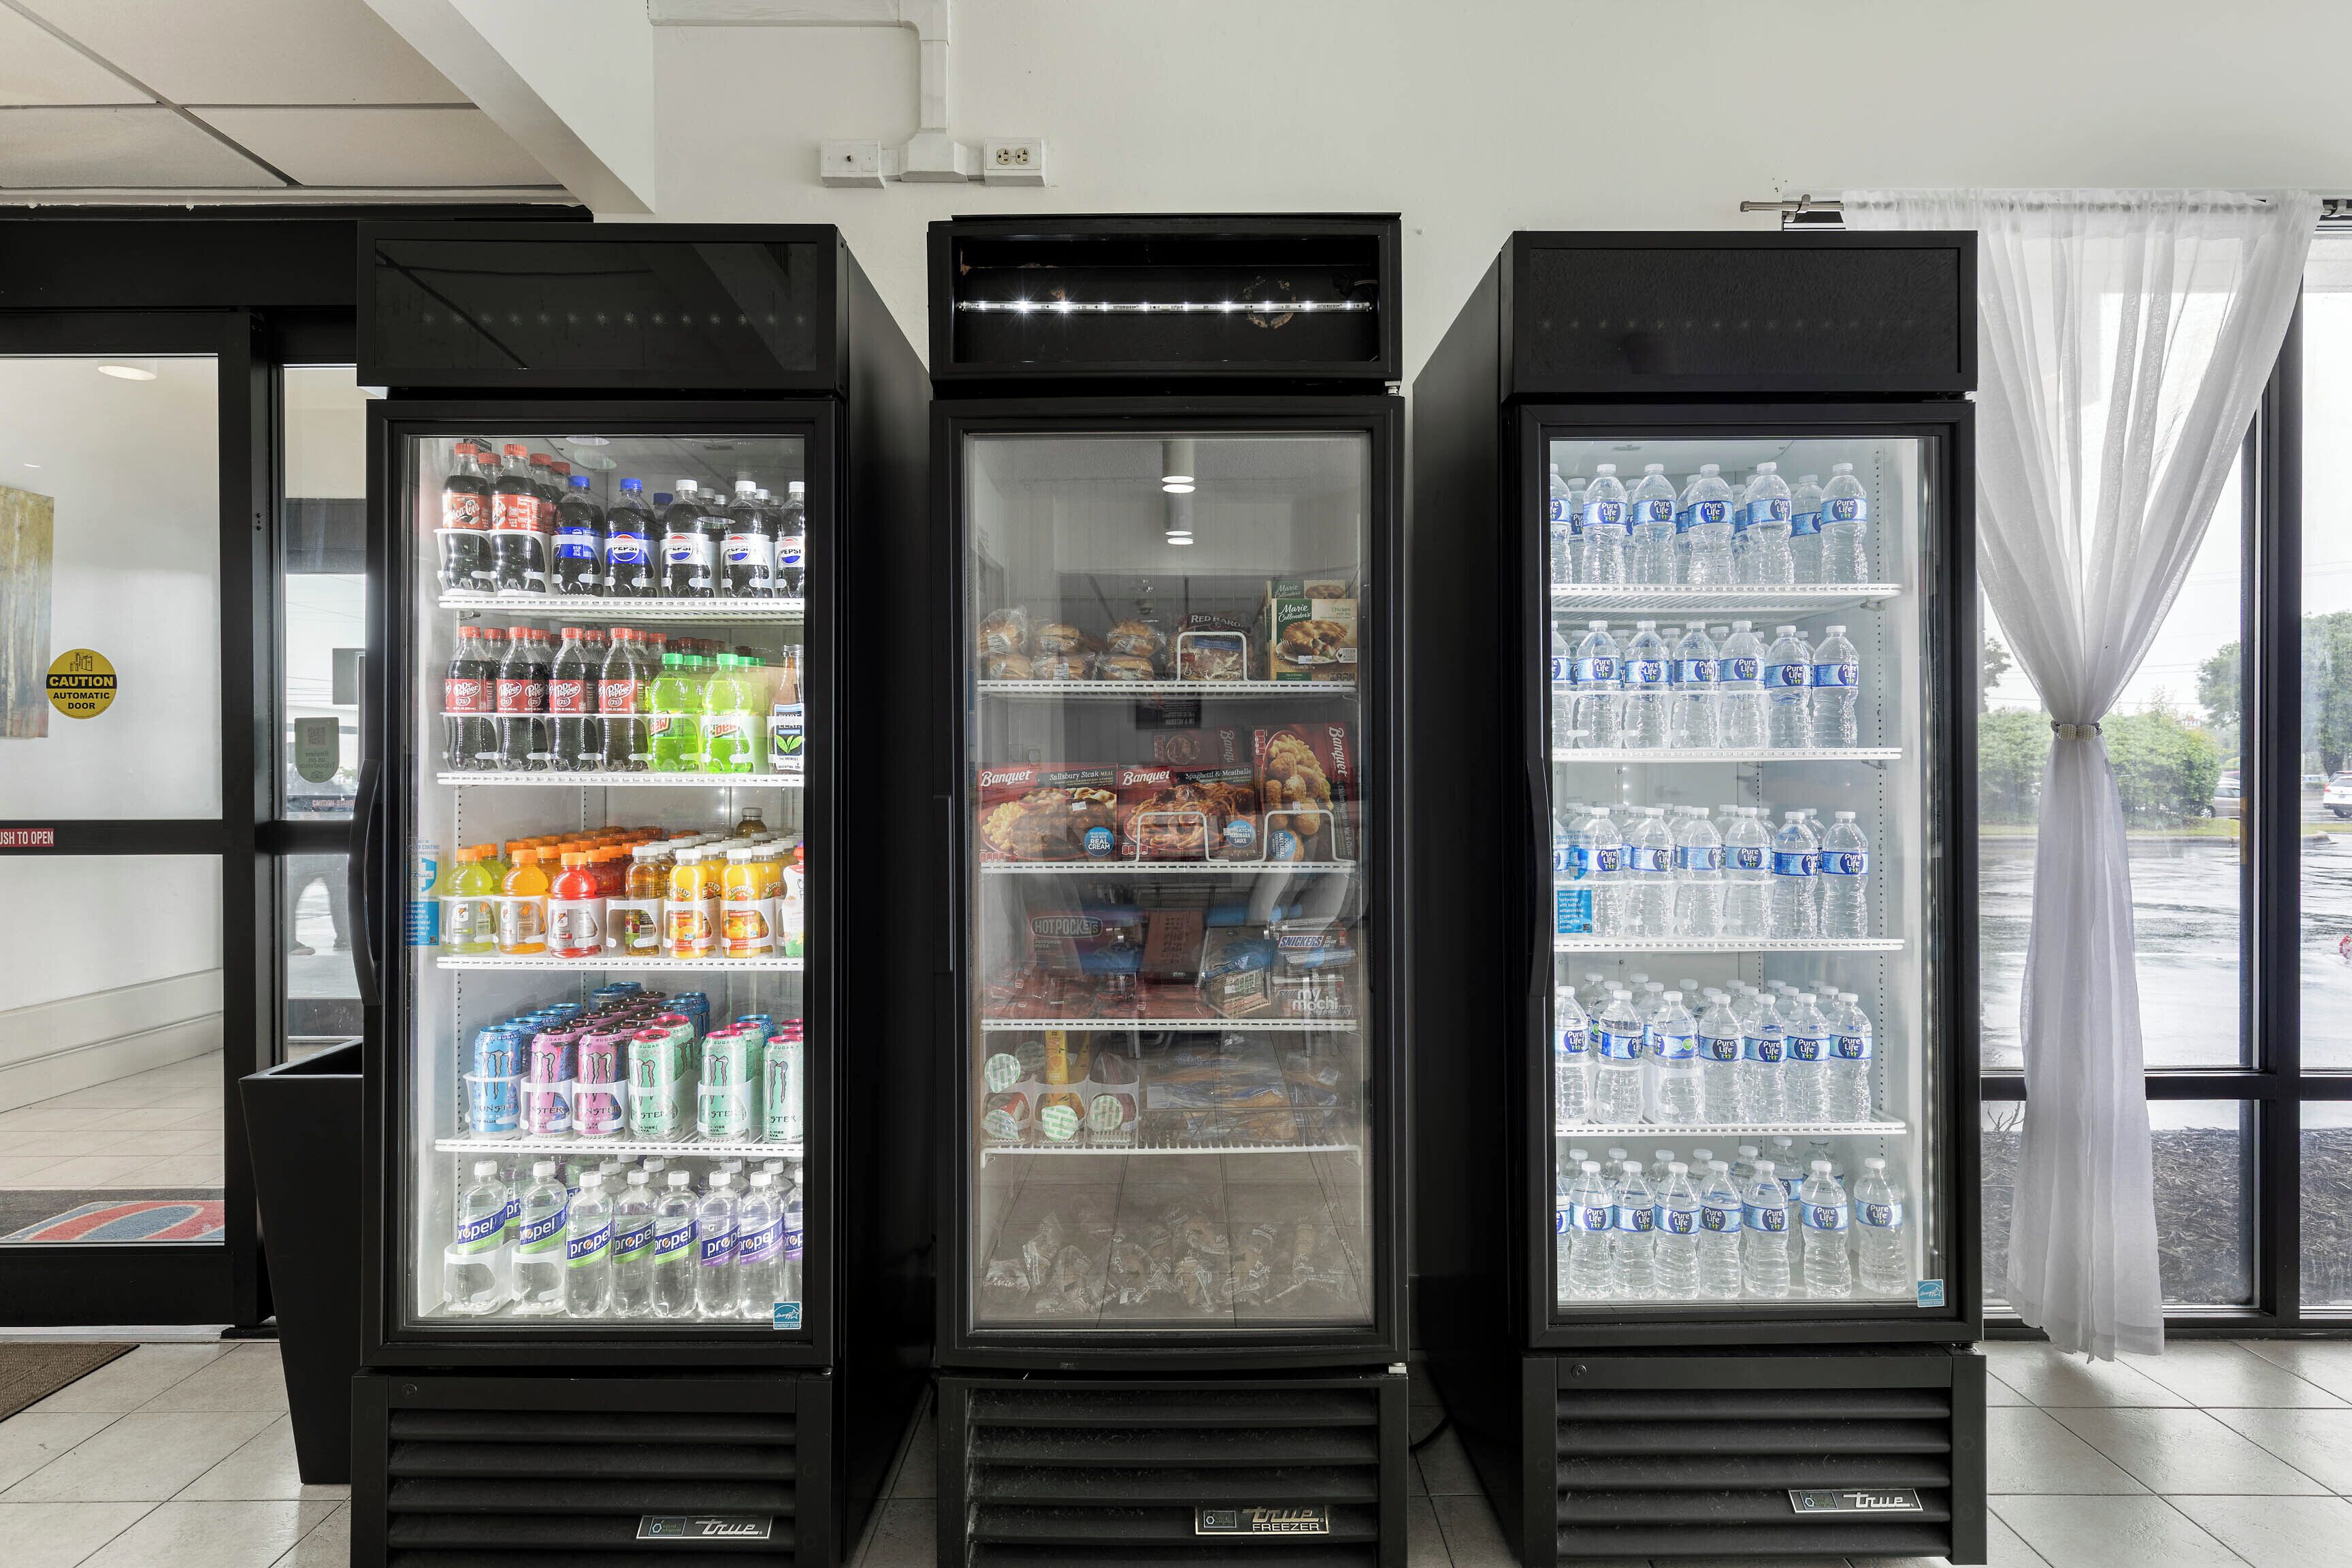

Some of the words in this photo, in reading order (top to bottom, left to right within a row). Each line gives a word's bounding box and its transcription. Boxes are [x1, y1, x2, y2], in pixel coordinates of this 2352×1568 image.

[1603, 509, 1616, 517] Life
[1656, 507, 1669, 515] Life
[1838, 506, 1852, 514] Life
[1275, 585, 1299, 593] Marie
[1279, 604, 1309, 615] Marie
[1191, 615, 1211, 623] RED
[1213, 616, 1243, 627] BARO
[1596, 665, 1609, 673] Life
[1644, 668, 1658, 676] Life
[1741, 666, 1754, 674] Life
[49, 676, 114, 687] CAUTION
[555, 685, 578, 697] Pepper
[607, 685, 630, 698] Pepper
[1220, 728, 1235, 763] Banqu
[1328, 726, 1347, 777] Banquet
[981, 769, 1033, 787] Banquet
[1049, 772, 1080, 781] Salisbury
[1122, 769, 1171, 786] Banquet
[1186, 771, 1214, 781] Spaghetti
[1222, 768, 1252, 776] Meatballs
[0, 832, 14, 845] USH
[17, 832, 28, 844] TO
[31, 832, 54, 845] OPEN
[1603, 856, 1616, 864] Life
[1744, 854, 1757, 863] Life
[1279, 936, 1322, 947] SNICKERS
[1297, 988, 1321, 1002] my
[1719, 1045, 1733, 1054] Life
[1765, 1047, 1778, 1055] Life
[1801, 1045, 1814, 1054] Life
[1845, 1043, 1859, 1051] Life
[1705, 1208, 1722, 1216] Pure
[1872, 1211, 1887, 1220] Life
[1639, 1216, 1650, 1224] Life
[1675, 1218, 1688, 1226] Life
[1706, 1215, 1720, 1224] Life
[1769, 1216, 1782, 1224] Life
[1820, 1214, 1833, 1222] Life
[457, 1218, 493, 1241] ropel
[520, 1217, 555, 1241] ropel
[571, 1224, 610, 1258] propel
[615, 1225, 653, 1254] propel
[708, 1228, 740, 1257] prope
[1252, 1523, 1320, 1531] FREEZER
